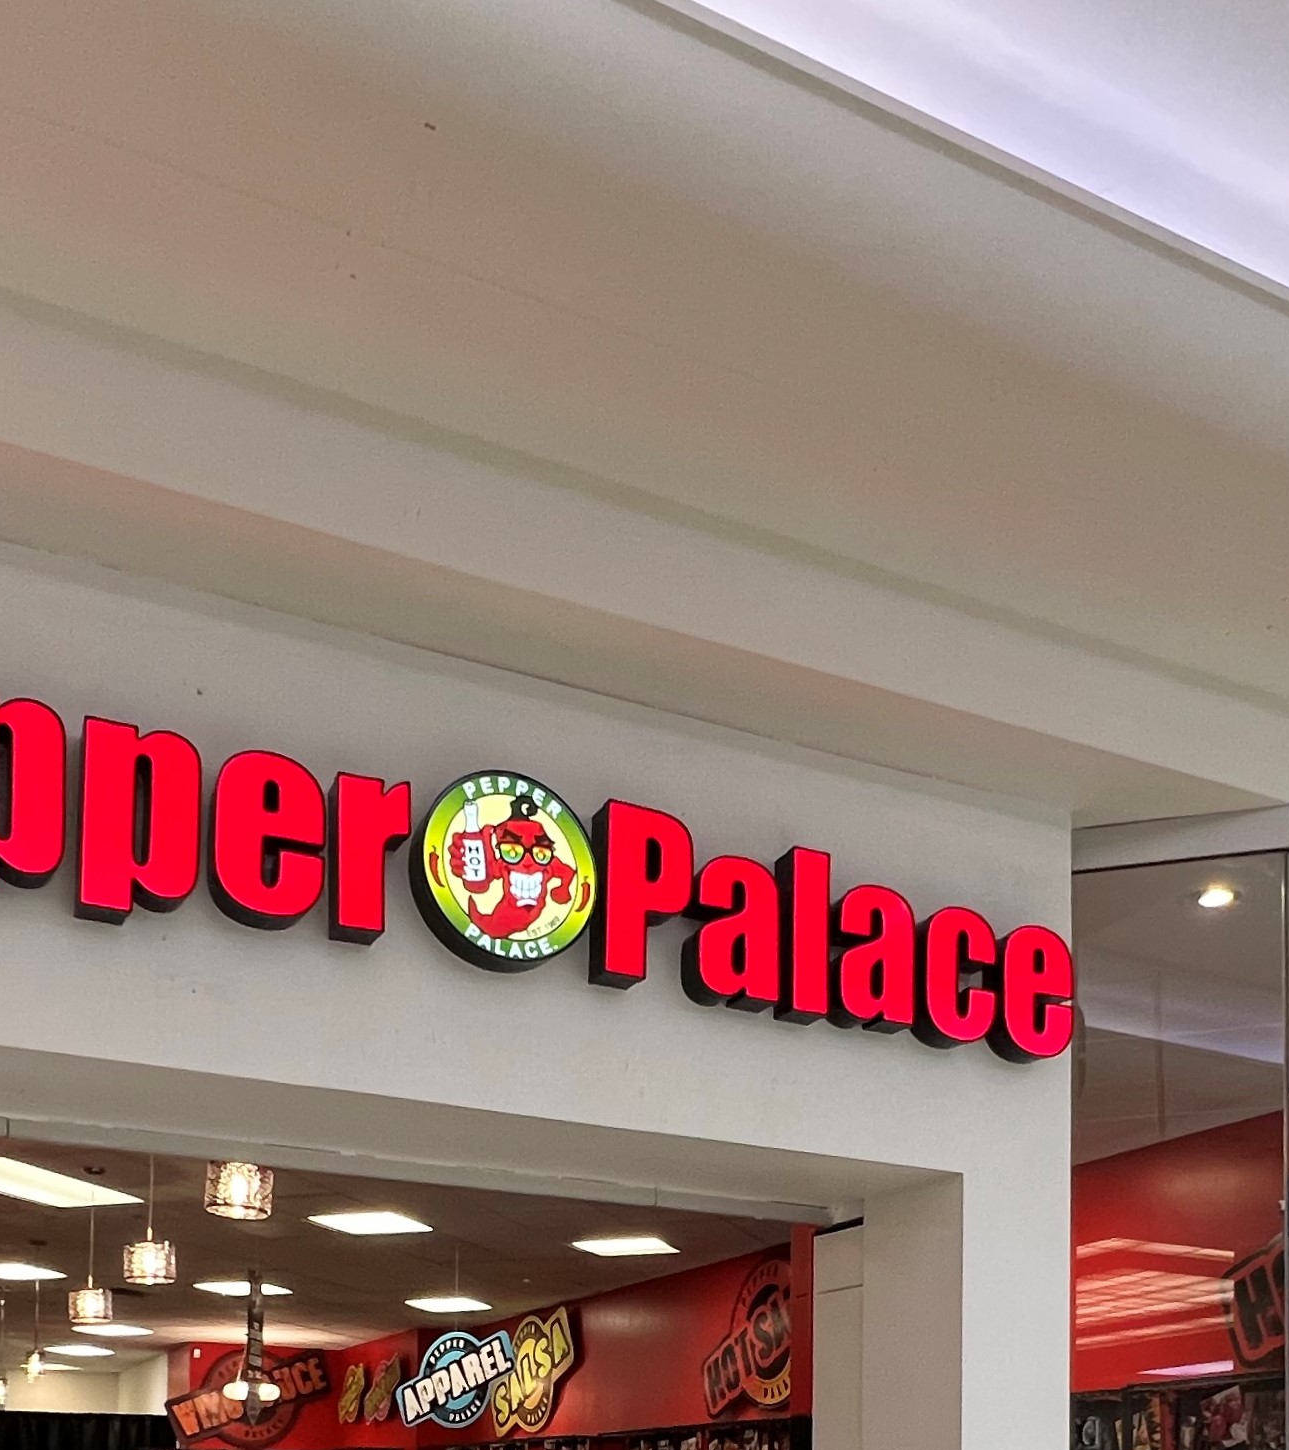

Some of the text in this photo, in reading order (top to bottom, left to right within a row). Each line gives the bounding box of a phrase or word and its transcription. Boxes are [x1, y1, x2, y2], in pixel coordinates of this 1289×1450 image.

[462, 776, 563, 820] PEPPER
[467, 845, 481, 878] HOT
[591, 798, 1075, 1062] Palace
[402, 1338, 512, 1423] APPAREL
[494, 1321, 569, 1425] SALSA
